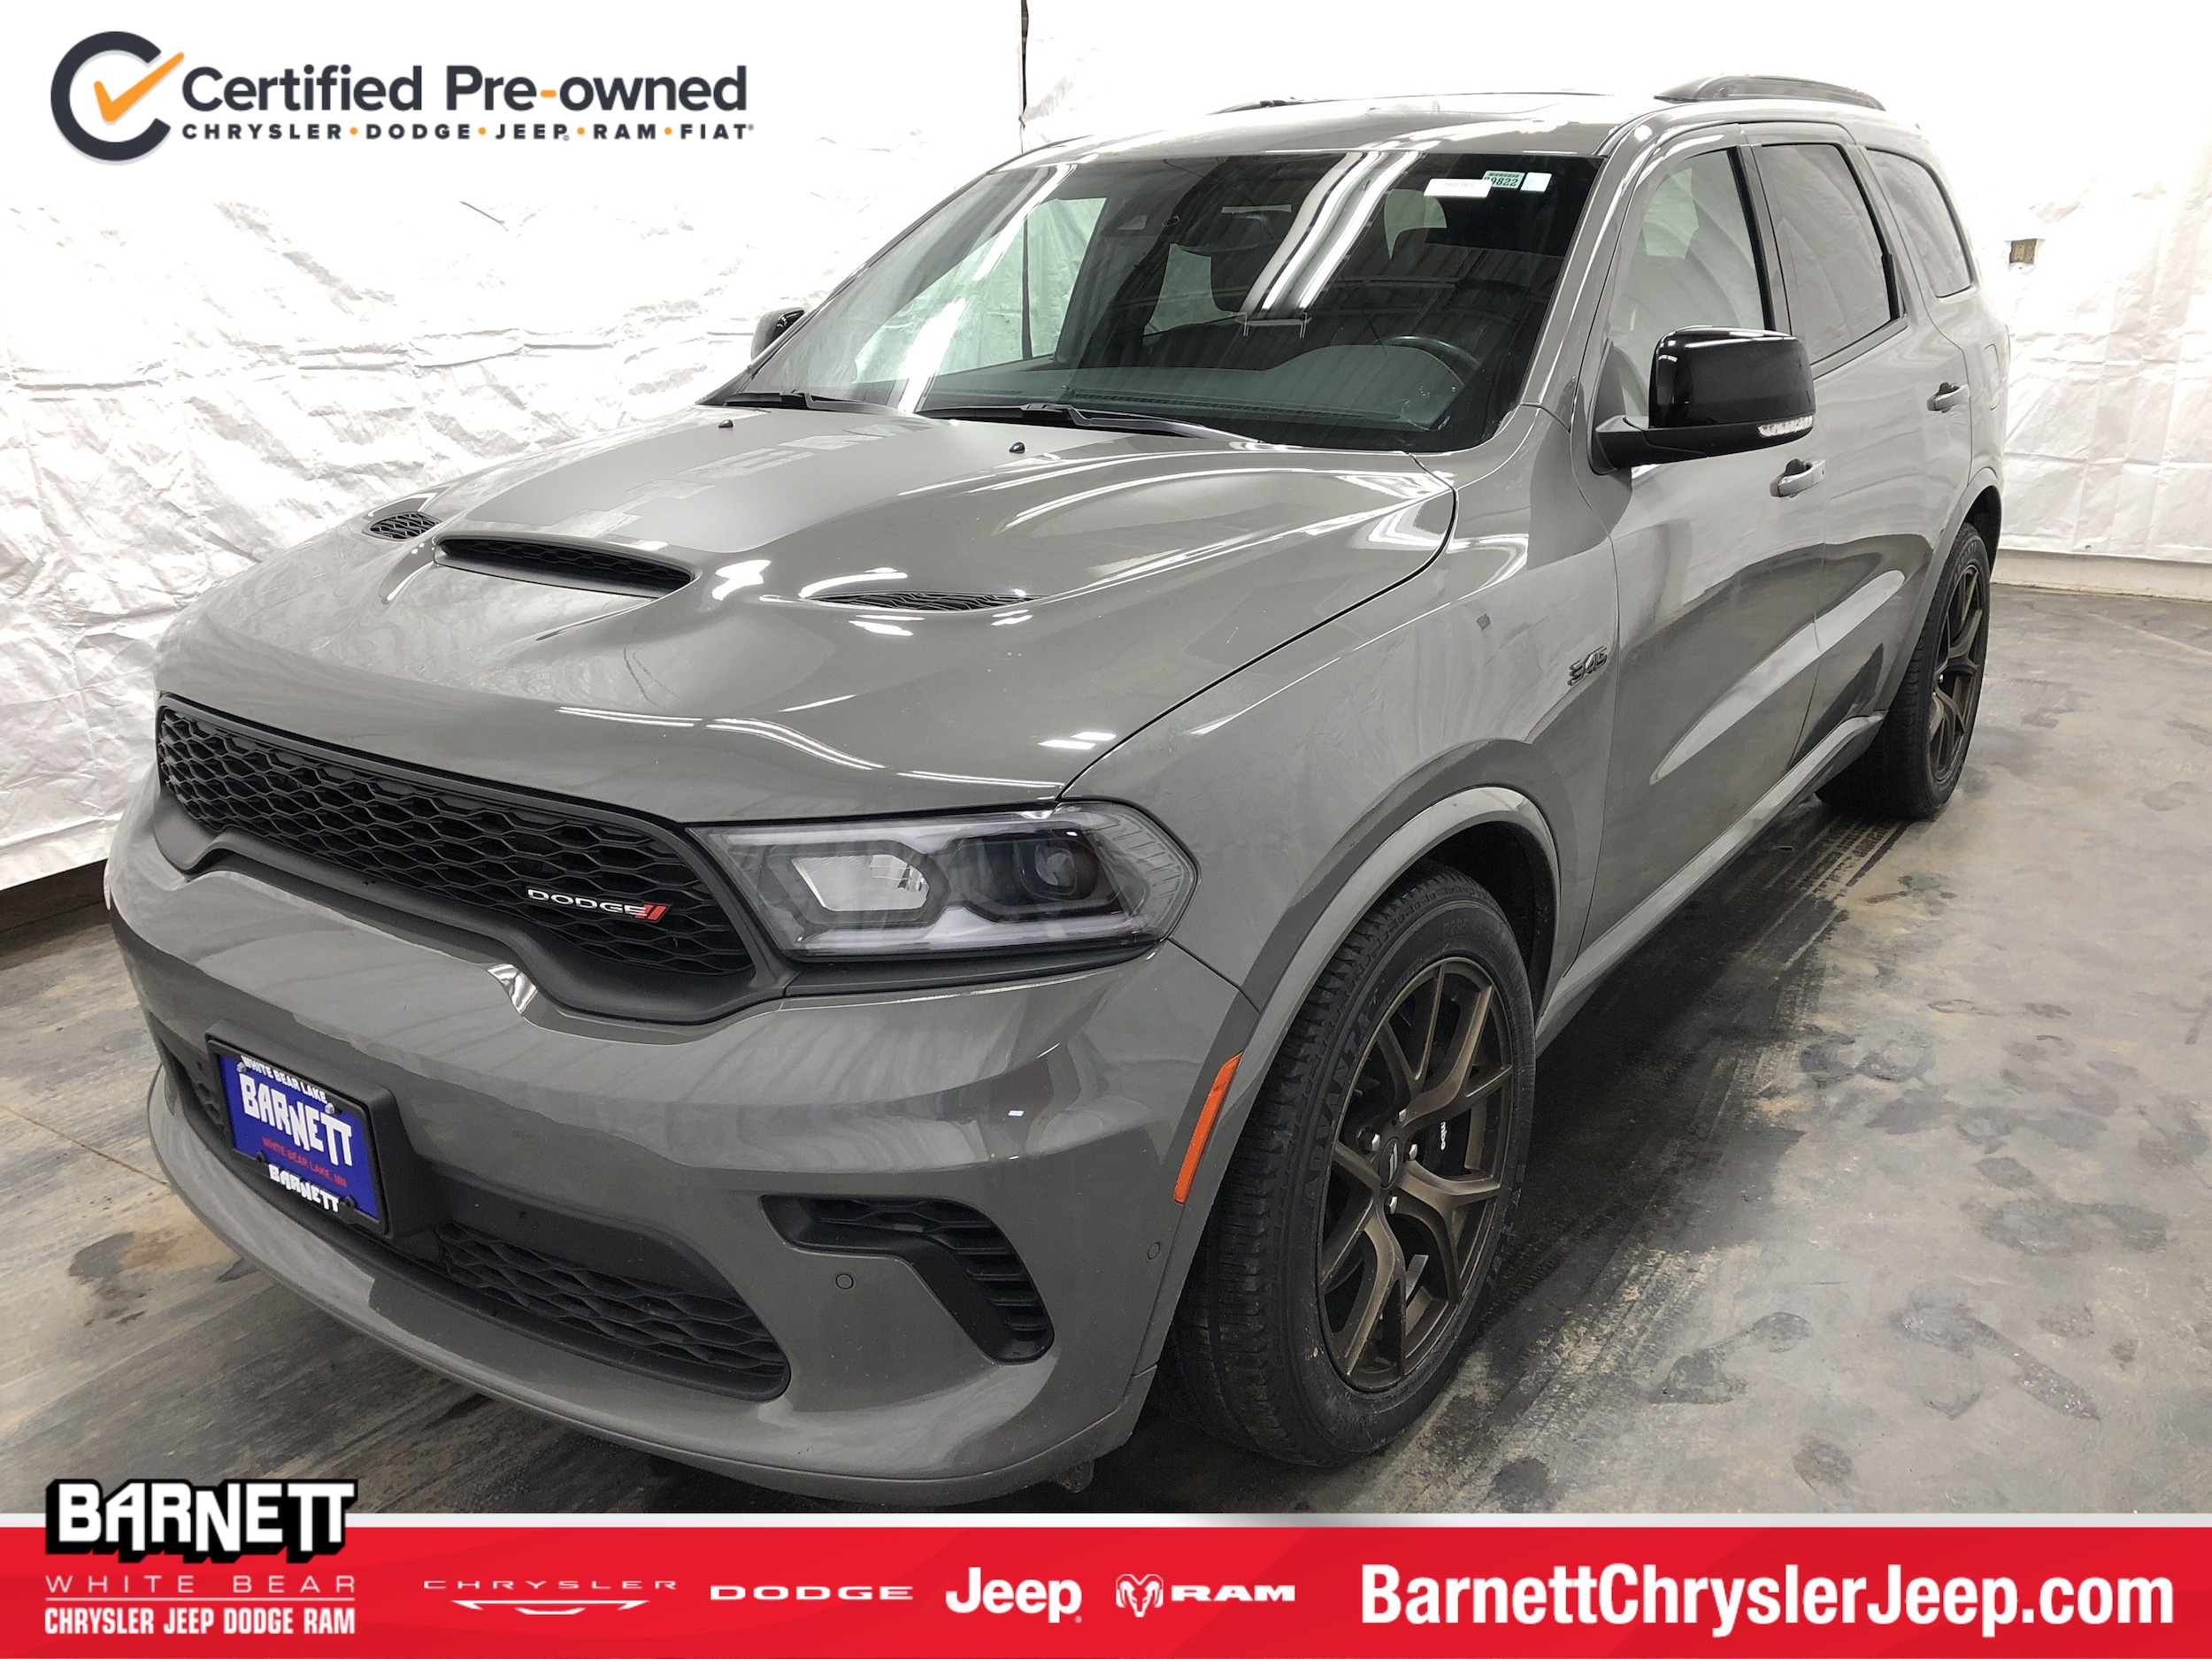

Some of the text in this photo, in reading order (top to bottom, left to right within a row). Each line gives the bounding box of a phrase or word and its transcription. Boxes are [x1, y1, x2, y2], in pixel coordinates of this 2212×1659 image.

[527, 888, 648, 917] DODGE
[240, 1055, 328, 1104] WHITE BEAR LAKE
[239, 1072, 353, 1167] BARNETT
[261, 1136, 288, 1156] WHITE
[287, 1148, 308, 1168] BEAR
[267, 1163, 340, 1213] BARNETT
